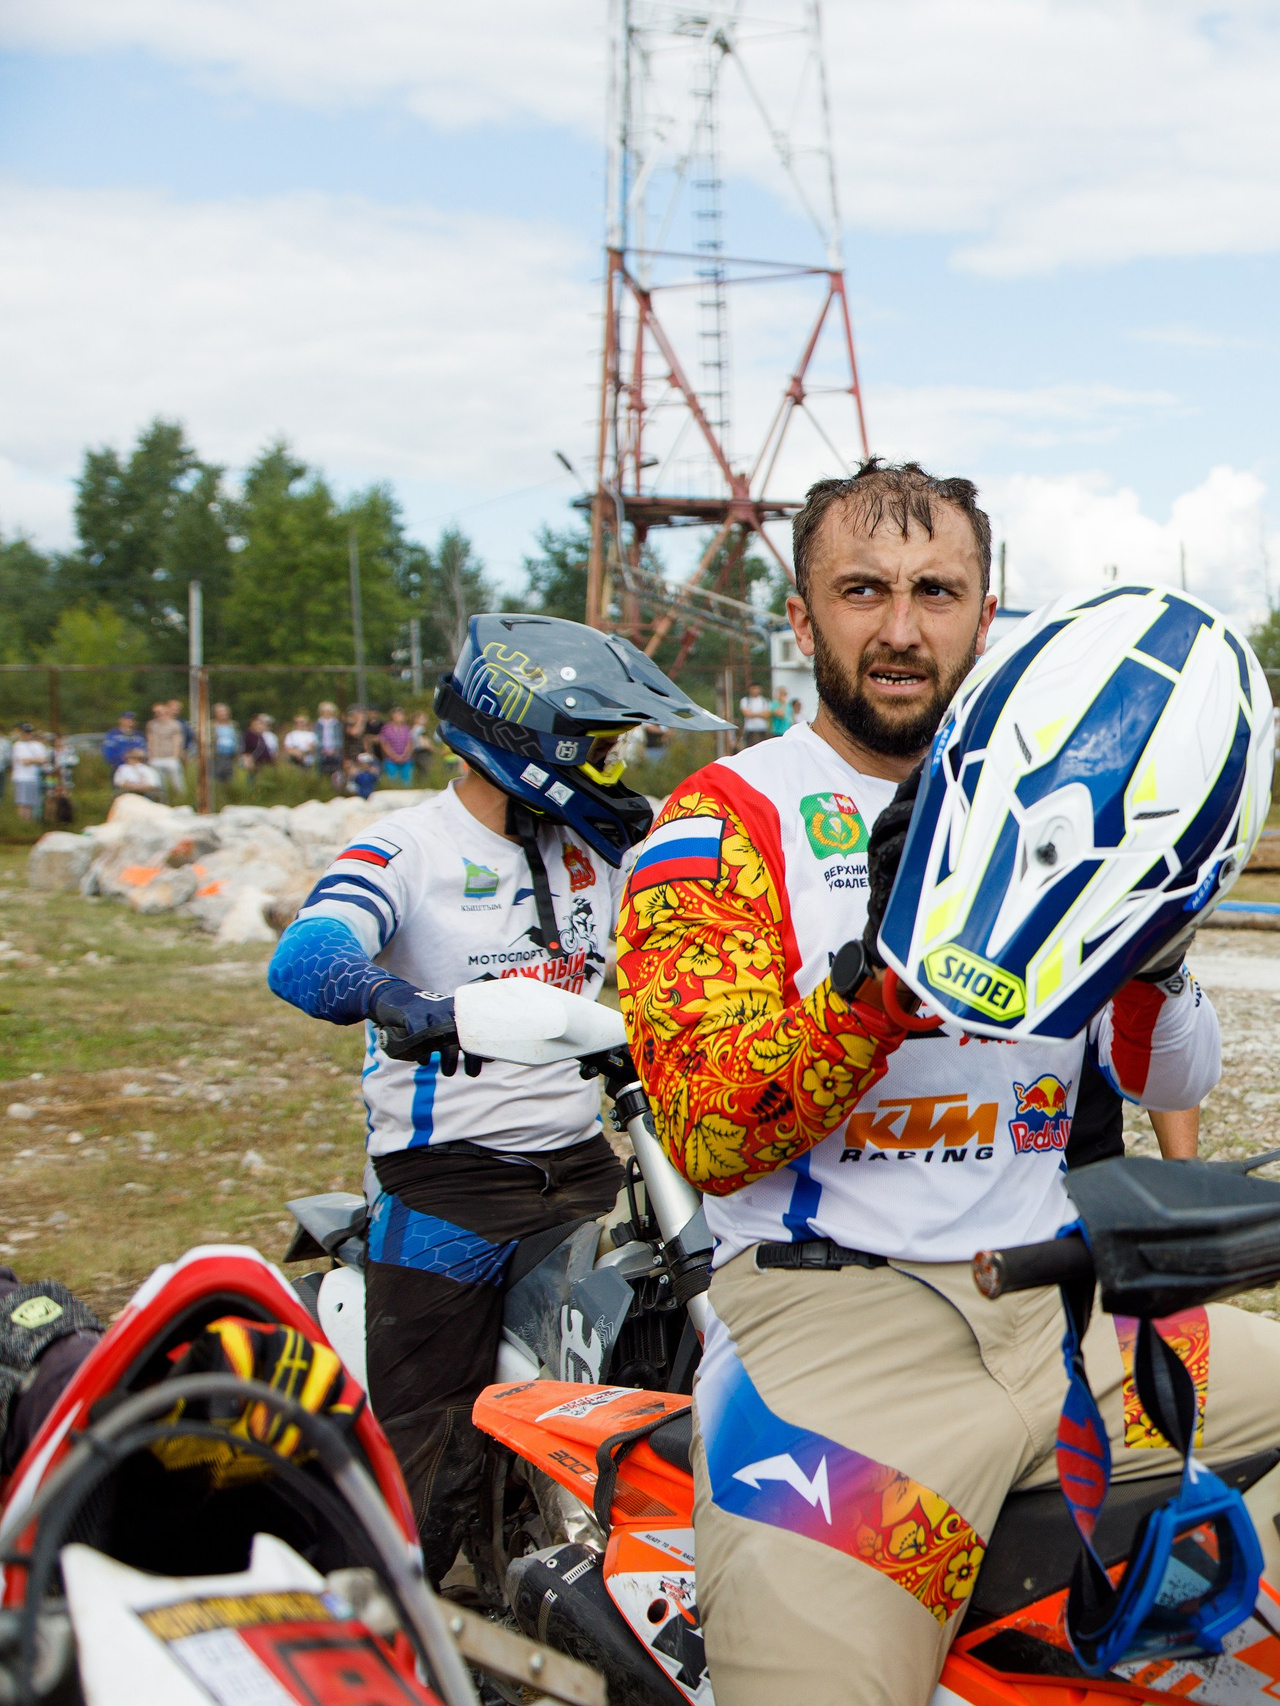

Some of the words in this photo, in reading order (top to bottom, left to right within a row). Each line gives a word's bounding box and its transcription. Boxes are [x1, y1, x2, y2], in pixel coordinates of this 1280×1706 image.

[824, 864, 869, 882] ВЕРХНИ
[829, 877, 870, 892] УФАЛЕ
[461, 903, 502, 912] КЫШТЫМ
[468, 948, 545, 965] МОТОСПОРТ
[938, 955, 1015, 1010] SHOEI
[844, 1093, 999, 1150] KTM
[839, 1146, 994, 1163] RACING
[683, 1552, 695, 1562] RAC
